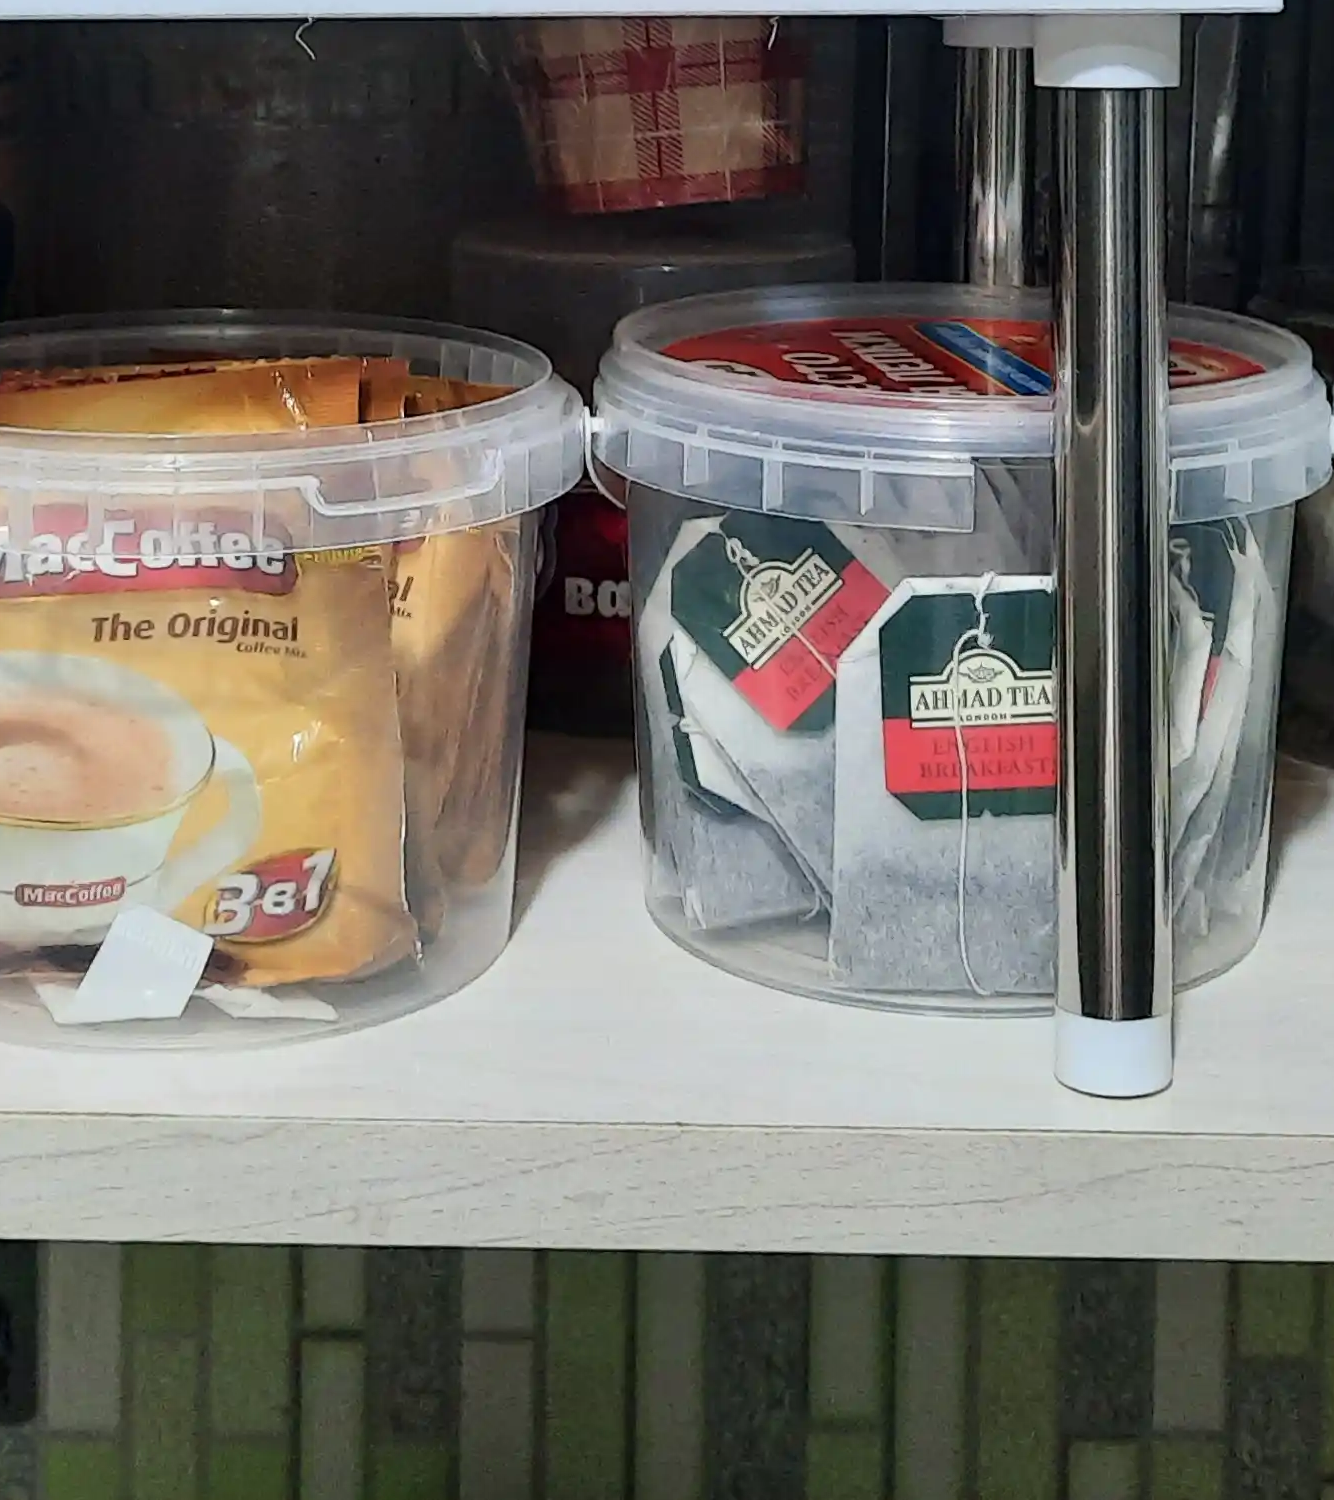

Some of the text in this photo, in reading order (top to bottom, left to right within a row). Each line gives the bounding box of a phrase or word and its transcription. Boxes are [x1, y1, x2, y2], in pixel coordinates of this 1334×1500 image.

[738, 590, 799, 658] AHMAD
[792, 562, 831, 598] TEA
[90, 609, 299, 646] The Original
[235, 641, 281, 655] Coffee
[915, 684, 1052, 712] AHMAD TEA
